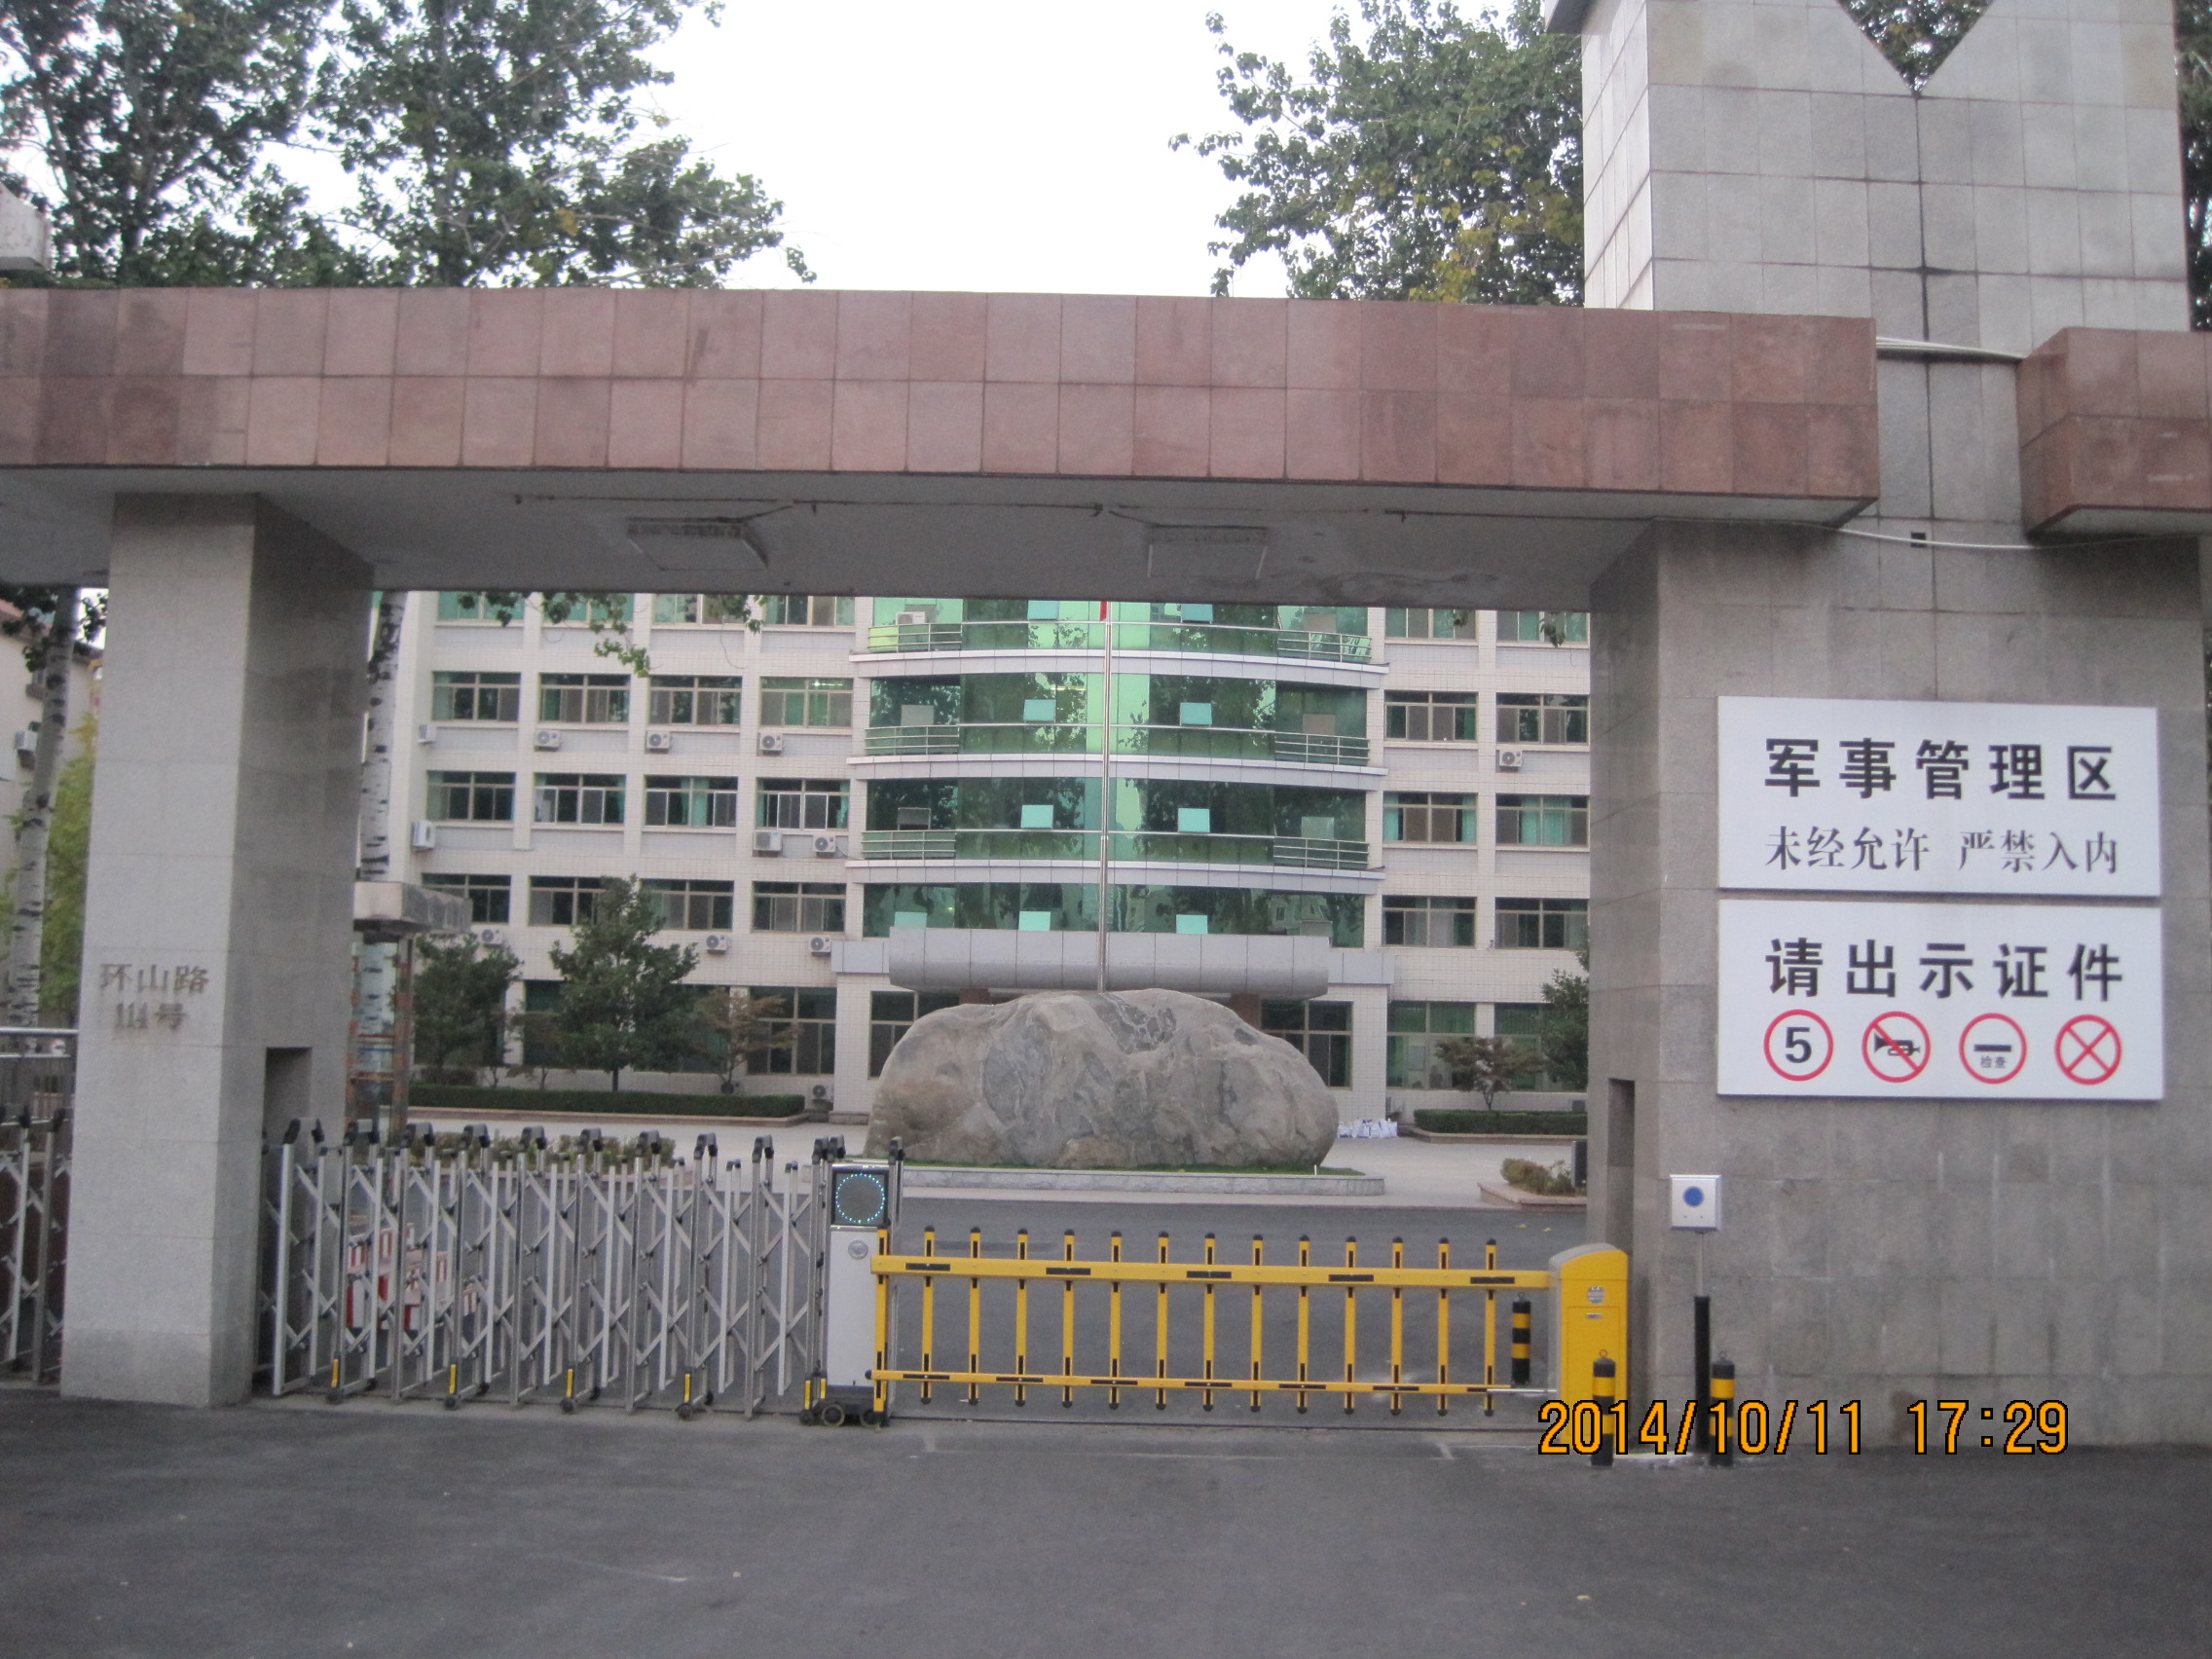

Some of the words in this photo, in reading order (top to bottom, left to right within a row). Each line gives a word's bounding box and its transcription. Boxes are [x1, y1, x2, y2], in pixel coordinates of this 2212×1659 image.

[1764, 737, 2118, 800] 军事管理区
[1764, 826, 1931, 871] 未经允许
[1958, 830, 2118, 874] 严禁入内
[99, 963, 209, 994] 环山路
[1764, 937, 2123, 1002] 请出示证件
[1785, 1026, 1813, 1064] 5
[1979, 1055, 2007, 1069] 检查
